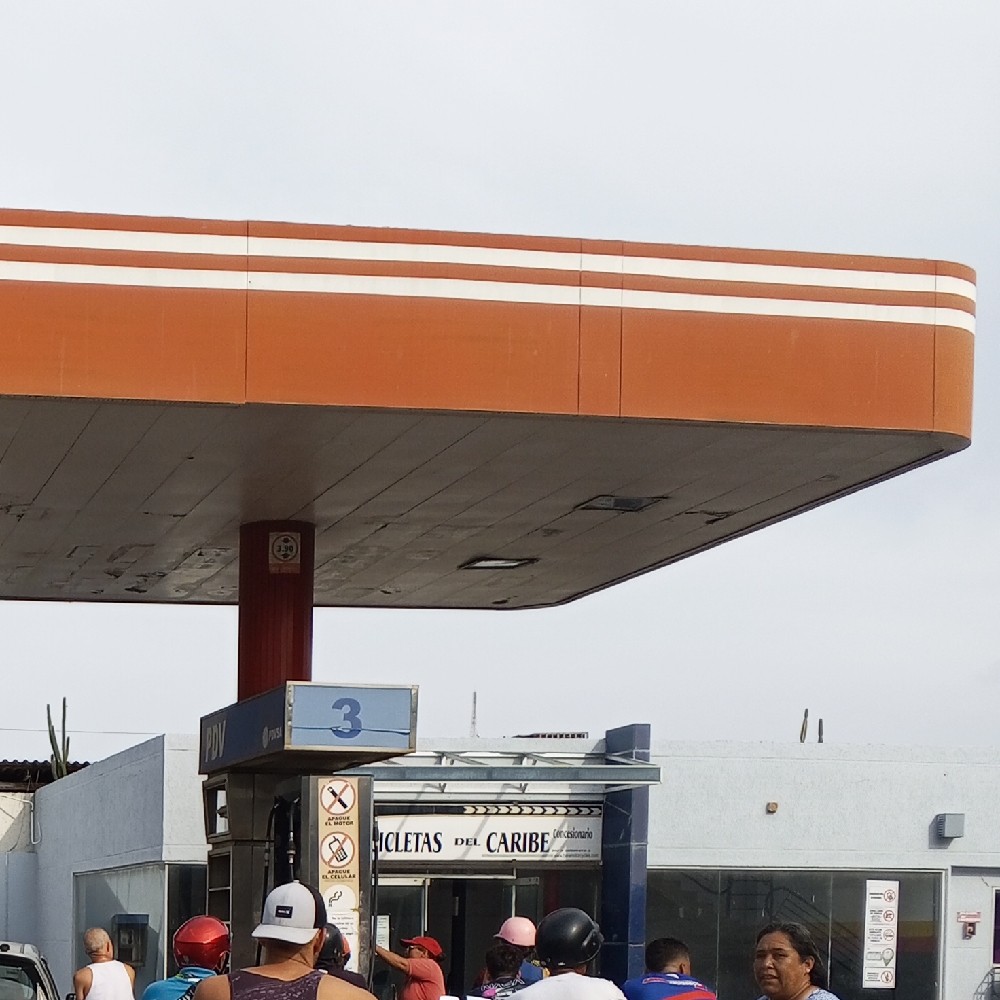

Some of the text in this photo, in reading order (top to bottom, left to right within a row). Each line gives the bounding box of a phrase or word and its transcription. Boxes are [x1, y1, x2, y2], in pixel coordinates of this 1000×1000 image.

[276, 544, 294, 553] 3.90
[331, 697, 362, 739] 3
[205, 719, 227, 763] PDV
[454, 837, 481, 847] DEL
[486, 831, 550, 854] CARIBE
[553, 826, 593, 839] Concesionario
